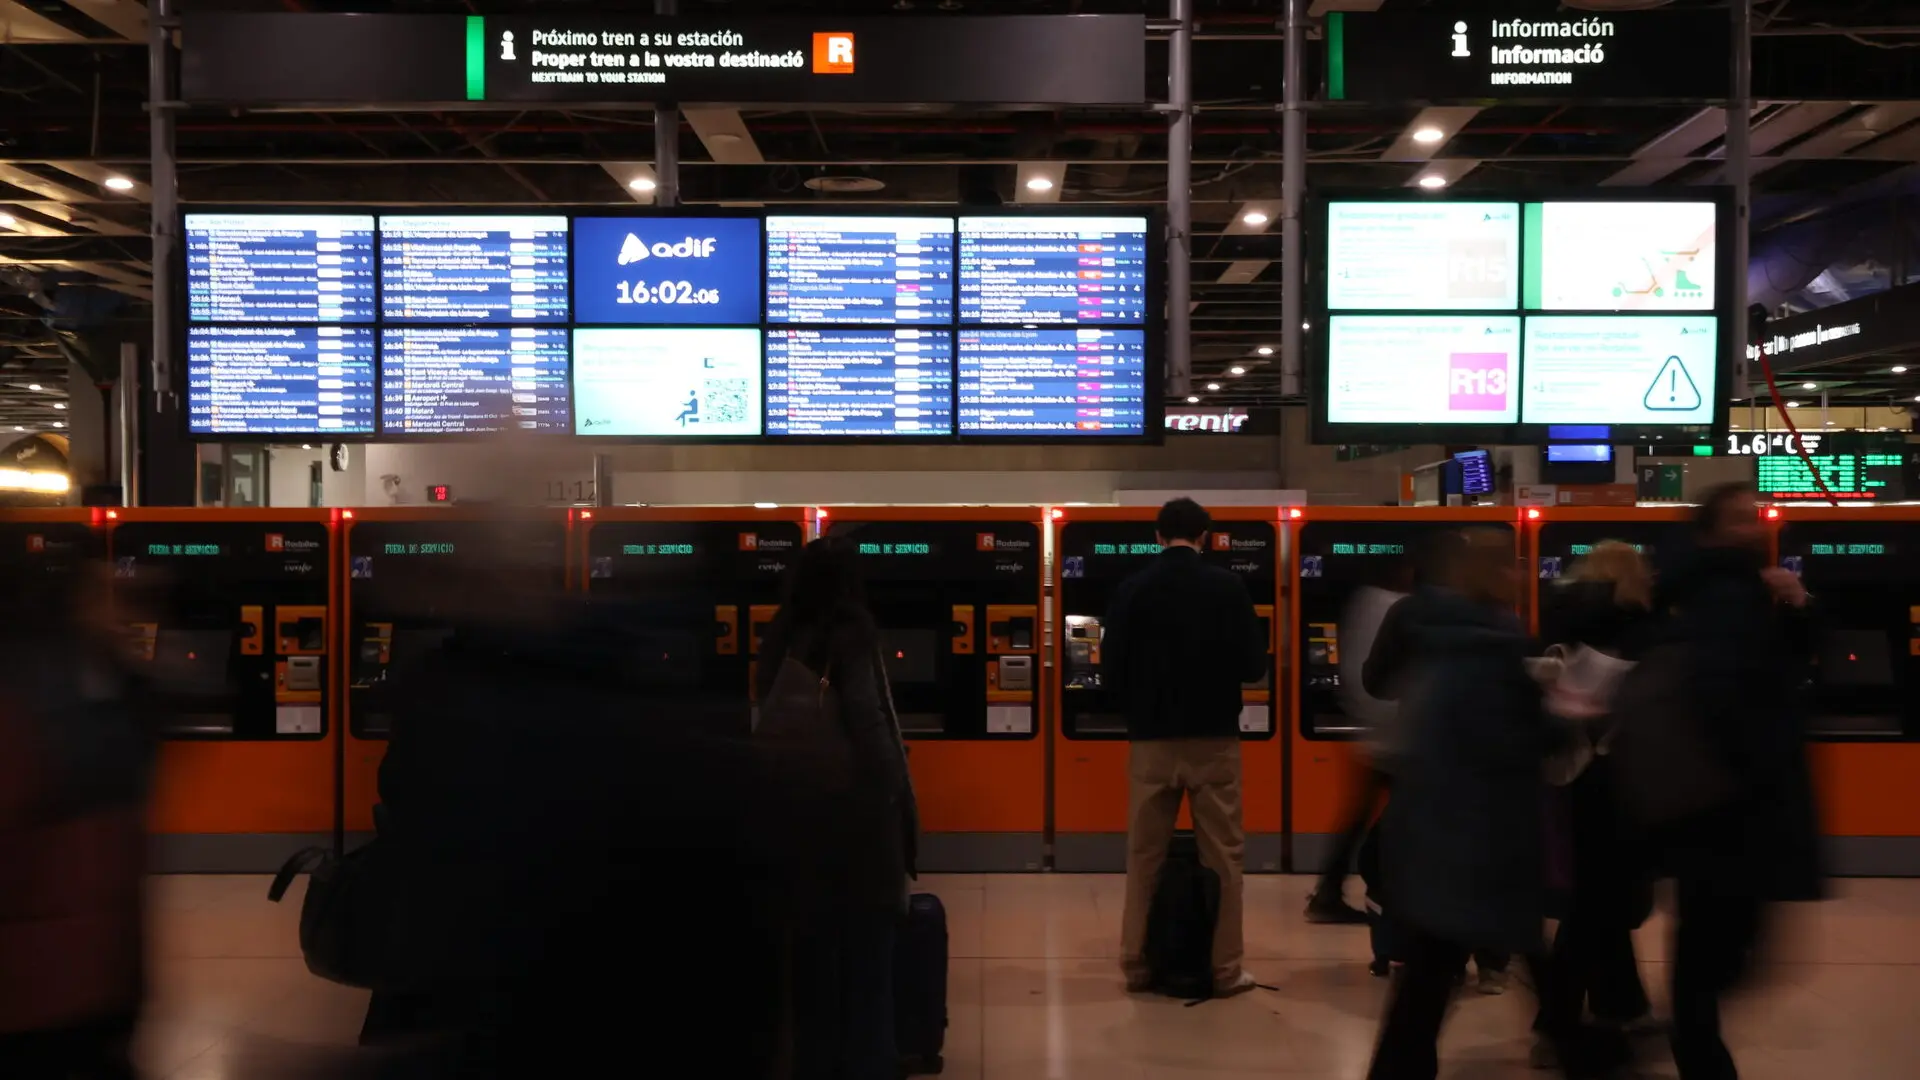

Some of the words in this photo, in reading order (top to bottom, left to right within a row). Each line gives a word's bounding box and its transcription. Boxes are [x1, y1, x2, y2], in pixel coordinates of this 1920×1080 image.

[1492, 17, 1615, 37] Información
[532, 29, 598, 46] Próximo
[601, 31, 635, 46] tren
[640, 34, 650, 46] a
[654, 34, 673, 46] su
[677, 29, 744, 46] estación
[1491, 43, 1605, 64] Informació
[531, 51, 588, 70] Proper
[590, 51, 626, 67] tren
[629, 54, 641, 67] a
[645, 51, 661, 67] la
[663, 52, 715, 67] vostra
[719, 50, 804, 67] destinació
[586, 72, 599, 83] TO
[600, 72, 626, 83] YOUR
[627, 72, 666, 83] STATION
[1491, 72, 1573, 84] INFORMATION
[651, 237, 717, 258] adif
[1449, 367, 1507, 395] R13
[385, 542, 406, 554] FUERA
[408, 542, 418, 554] DE
[420, 542, 454, 554] SERVICIO
[658, 543, 693, 555] SERVICIO
[859, 543, 881, 555] FUERA
[884, 543, 893, 555] DE
[895, 543, 930, 555] SERVICIO
[1332, 543, 1355, 555] FUERA
[1357, 543, 1366, 555] DE
[1811, 543, 1834, 555] FUERA
[1848, 543, 1885, 555] SERVICIO
